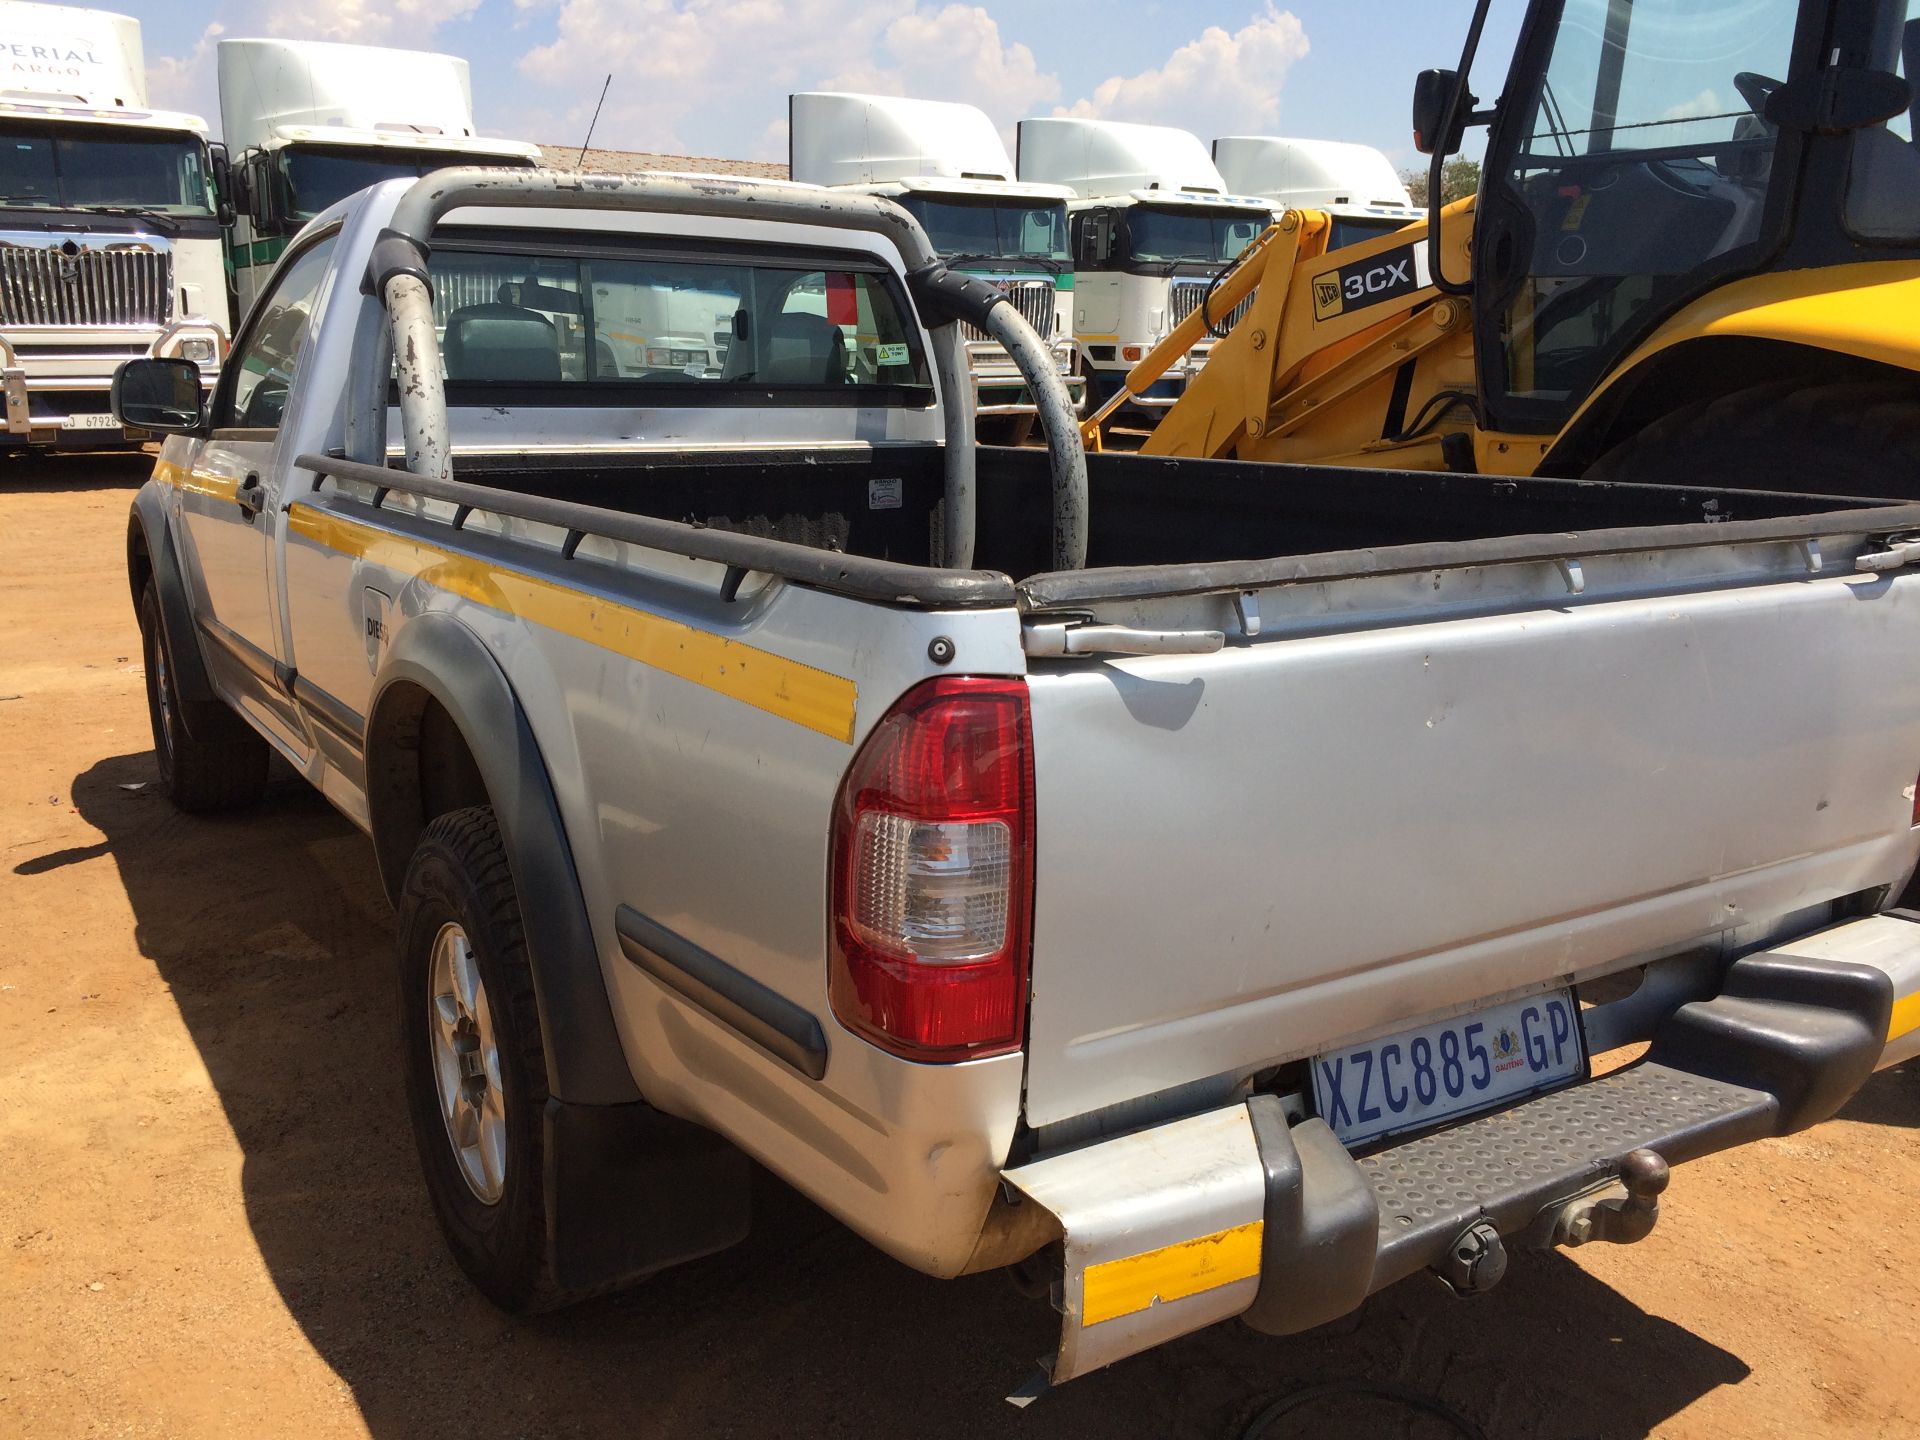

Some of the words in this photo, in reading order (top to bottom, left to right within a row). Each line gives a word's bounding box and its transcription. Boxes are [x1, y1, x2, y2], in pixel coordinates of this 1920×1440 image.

[0, 62, 80, 77] ARGO
[1344, 259, 1410, 300] 3CX
[1320, 284, 1340, 305] JCB
[1321, 1022, 1491, 1131] XZC885
[1521, 1001, 1569, 1073] GP
[1495, 1058, 1525, 1073] GAUTENG
